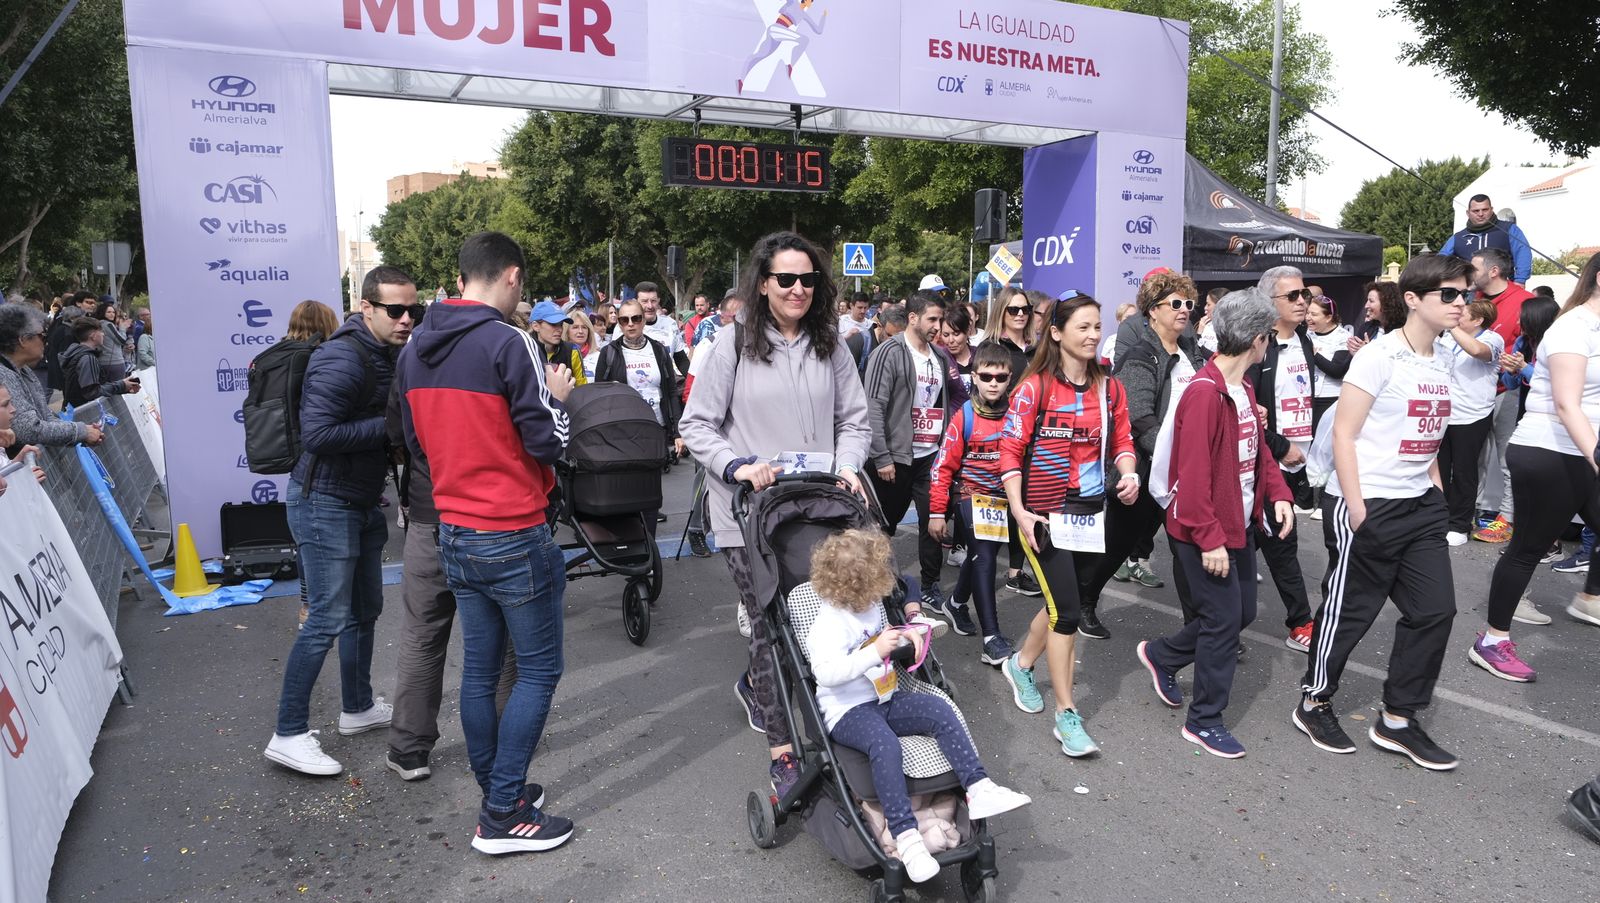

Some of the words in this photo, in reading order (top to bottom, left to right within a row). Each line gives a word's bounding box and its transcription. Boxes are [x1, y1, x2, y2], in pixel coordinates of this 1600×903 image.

[343, 0, 616, 57] MUJER
[958, 9, 982, 31] LA
[986, 13, 1076, 44] IGUALDAD
[928, 38, 953, 60] ES
[957, 41, 1044, 72] NUESTRA
[1047, 54, 1101, 78] META.
[937, 75, 968, 94] CDX
[191, 99, 276, 114] HYUNDAI
[203, 113, 268, 126] Almerialva
[215, 140, 284, 156] cajamar
[695, 144, 822, 187] 00:01:15
[1124, 165, 1163, 175] HYUNDAI
[203, 182, 263, 204] CASI
[1133, 192, 1164, 202] cajamar
[226, 219, 288, 235] vithas
[1125, 219, 1152, 234] CASI
[1032, 227, 1081, 267] CDX
[1133, 244, 1161, 254] vithas
[220, 266, 290, 285] aqualia
[230, 333, 276, 346] Clece
[625, 362, 652, 370] MUJER
[1417, 383, 1450, 395] MUJER
[1417, 417, 1442, 434] 904
[979, 508, 1004, 522] 1632
[1063, 514, 1096, 527] 1086
